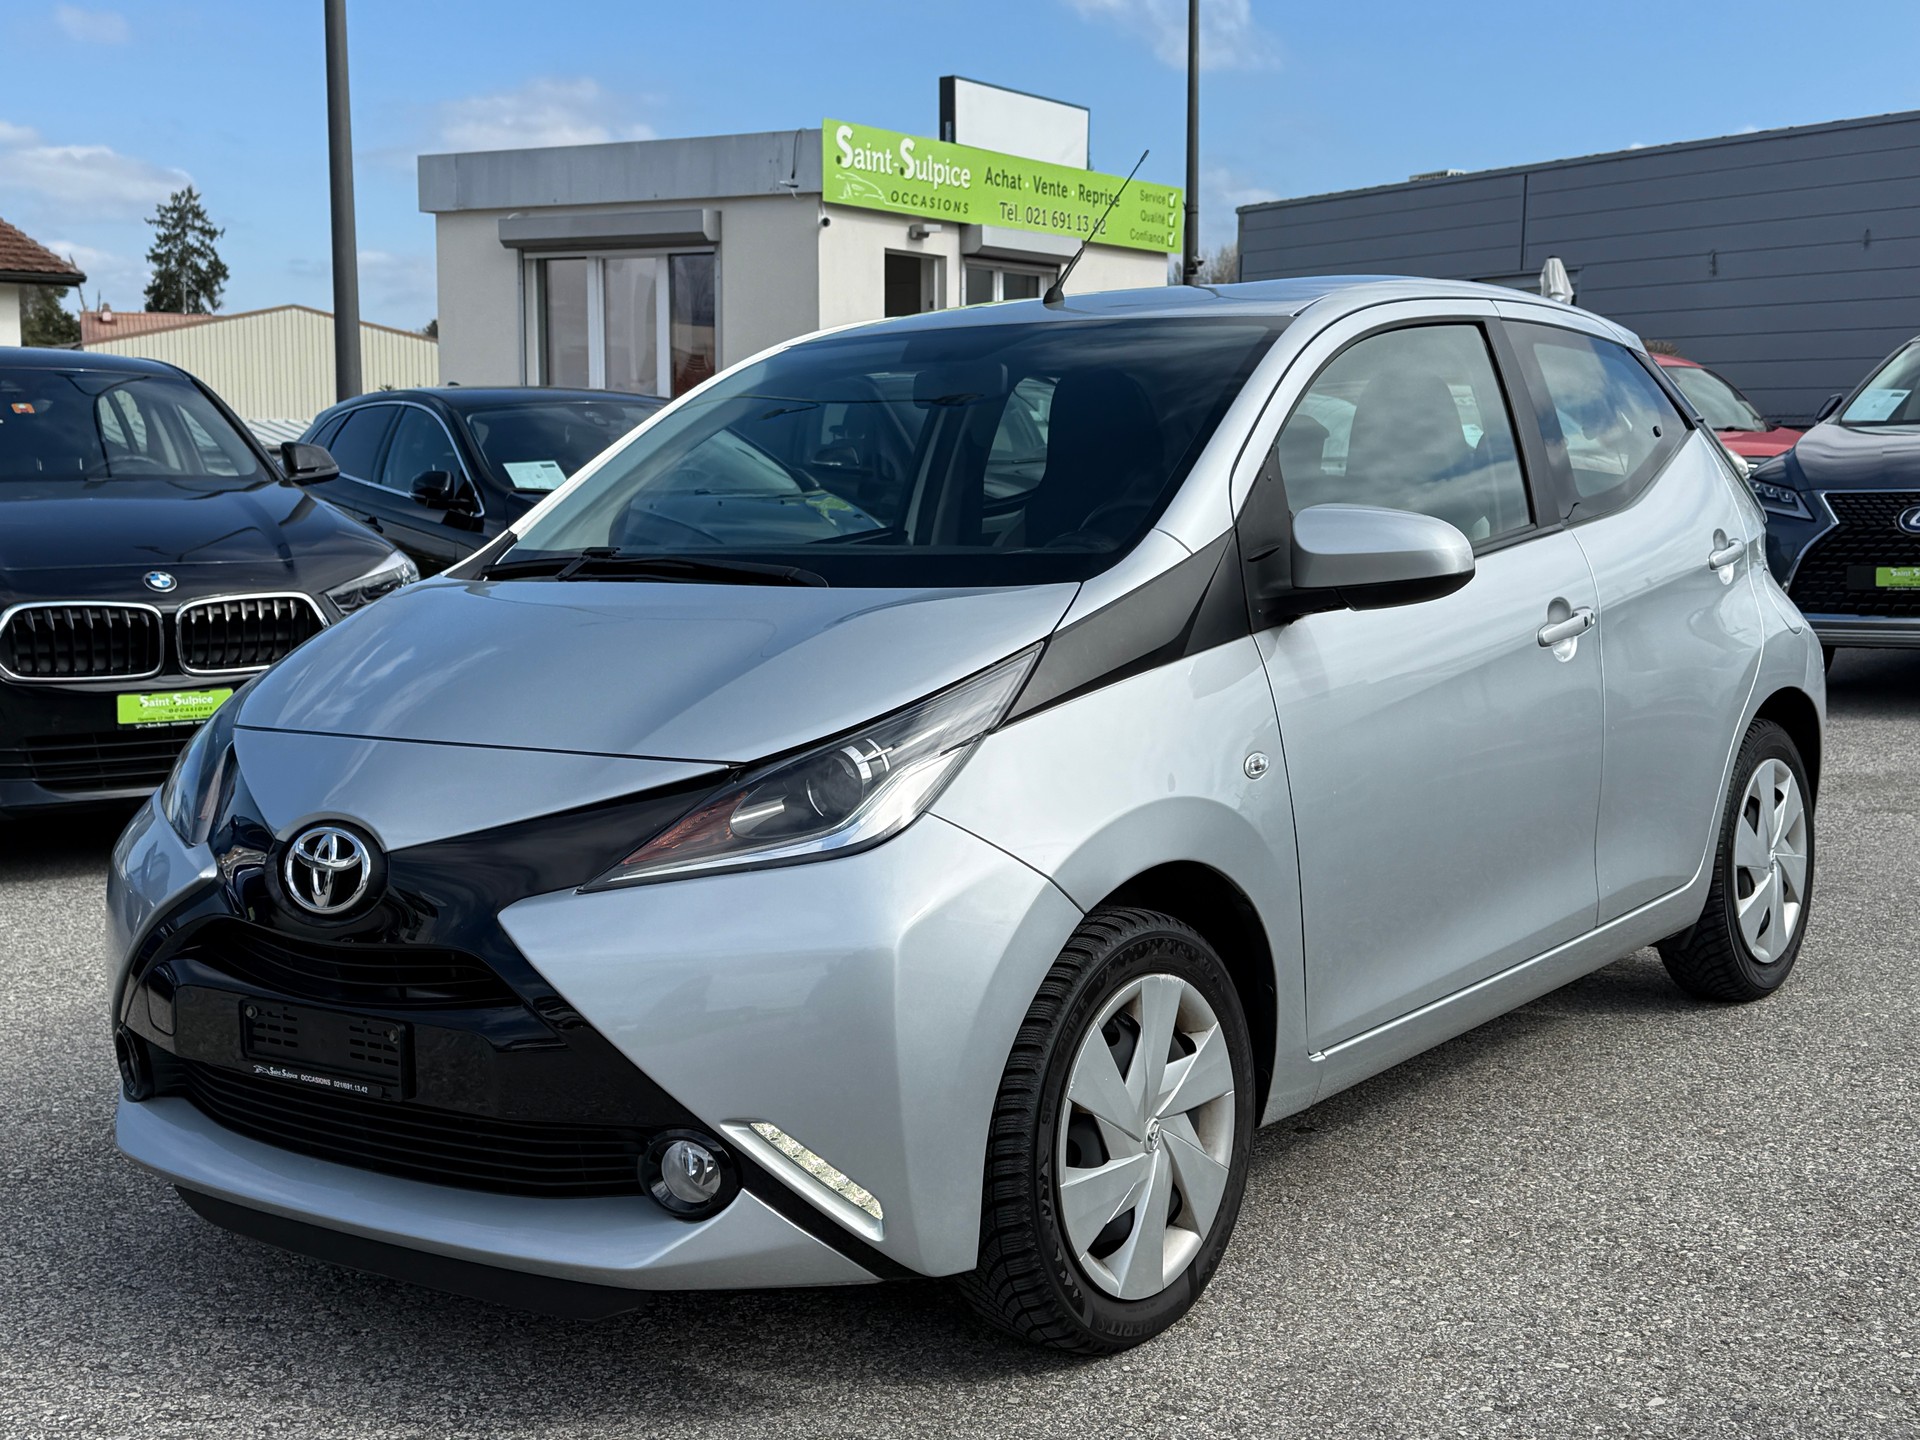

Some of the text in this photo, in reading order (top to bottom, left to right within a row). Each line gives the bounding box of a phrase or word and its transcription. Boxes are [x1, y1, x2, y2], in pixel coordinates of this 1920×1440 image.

[836, 125, 971, 189] Saint-Sulpice
[984, 167, 1120, 208] Achat Vente Reprise
[1140, 189, 1166, 205] Service
[890, 190, 969, 214] OCCASIONS
[1026, 206, 1047, 226] 021
[1051, 210, 1072, 230] 691
[1076, 215, 1089, 233] 13
[1130, 228, 1165, 245] Confiance
[301, 1074, 331, 1086] OCCASIONS
